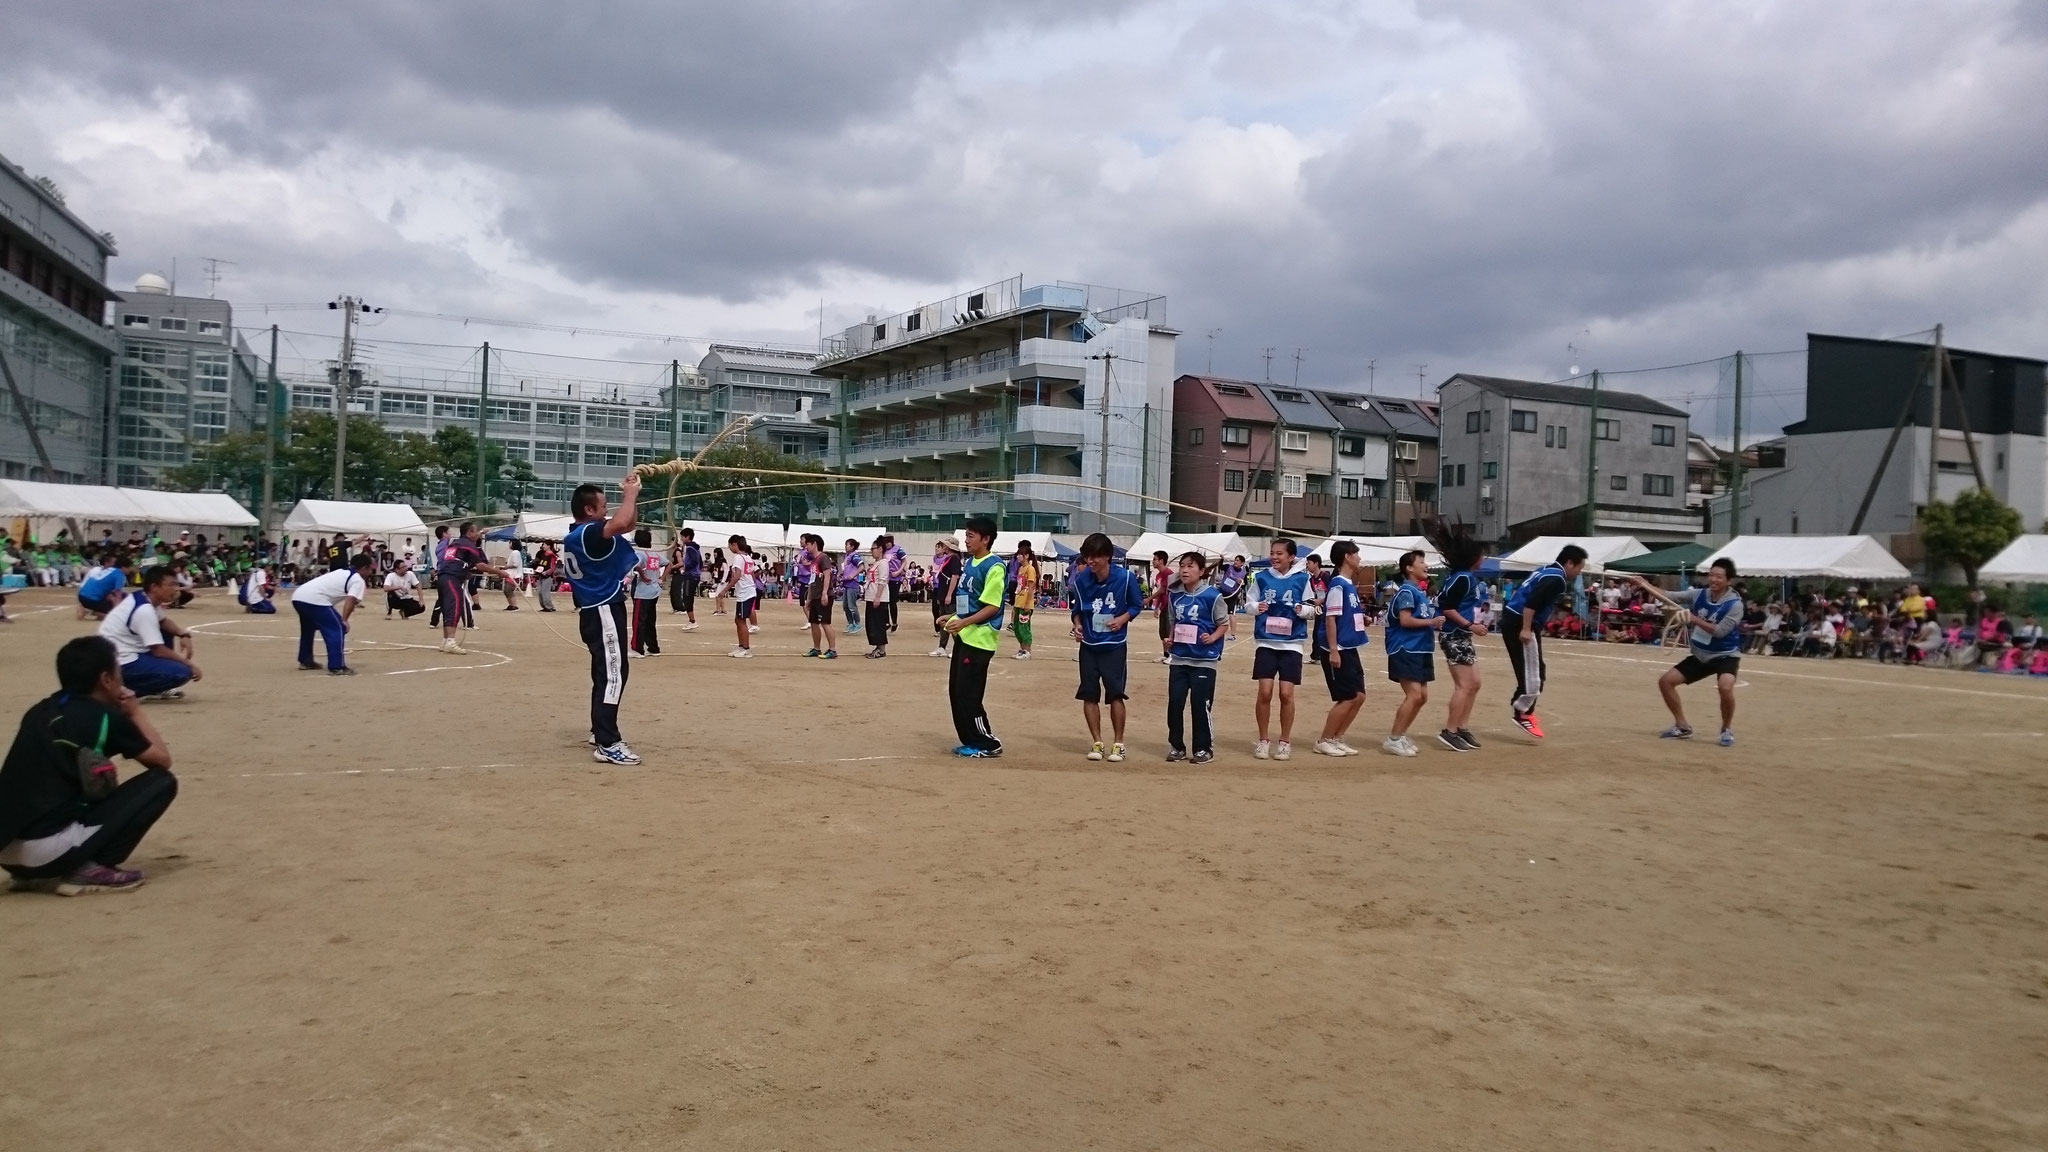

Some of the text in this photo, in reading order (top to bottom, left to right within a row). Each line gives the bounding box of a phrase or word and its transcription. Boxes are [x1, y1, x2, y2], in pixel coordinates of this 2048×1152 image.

[966, 576, 974, 593] 4
[1105, 591, 1116, 609] 4
[1264, 588, 1293, 606] 東 4
[1187, 604, 1199, 621] 4
